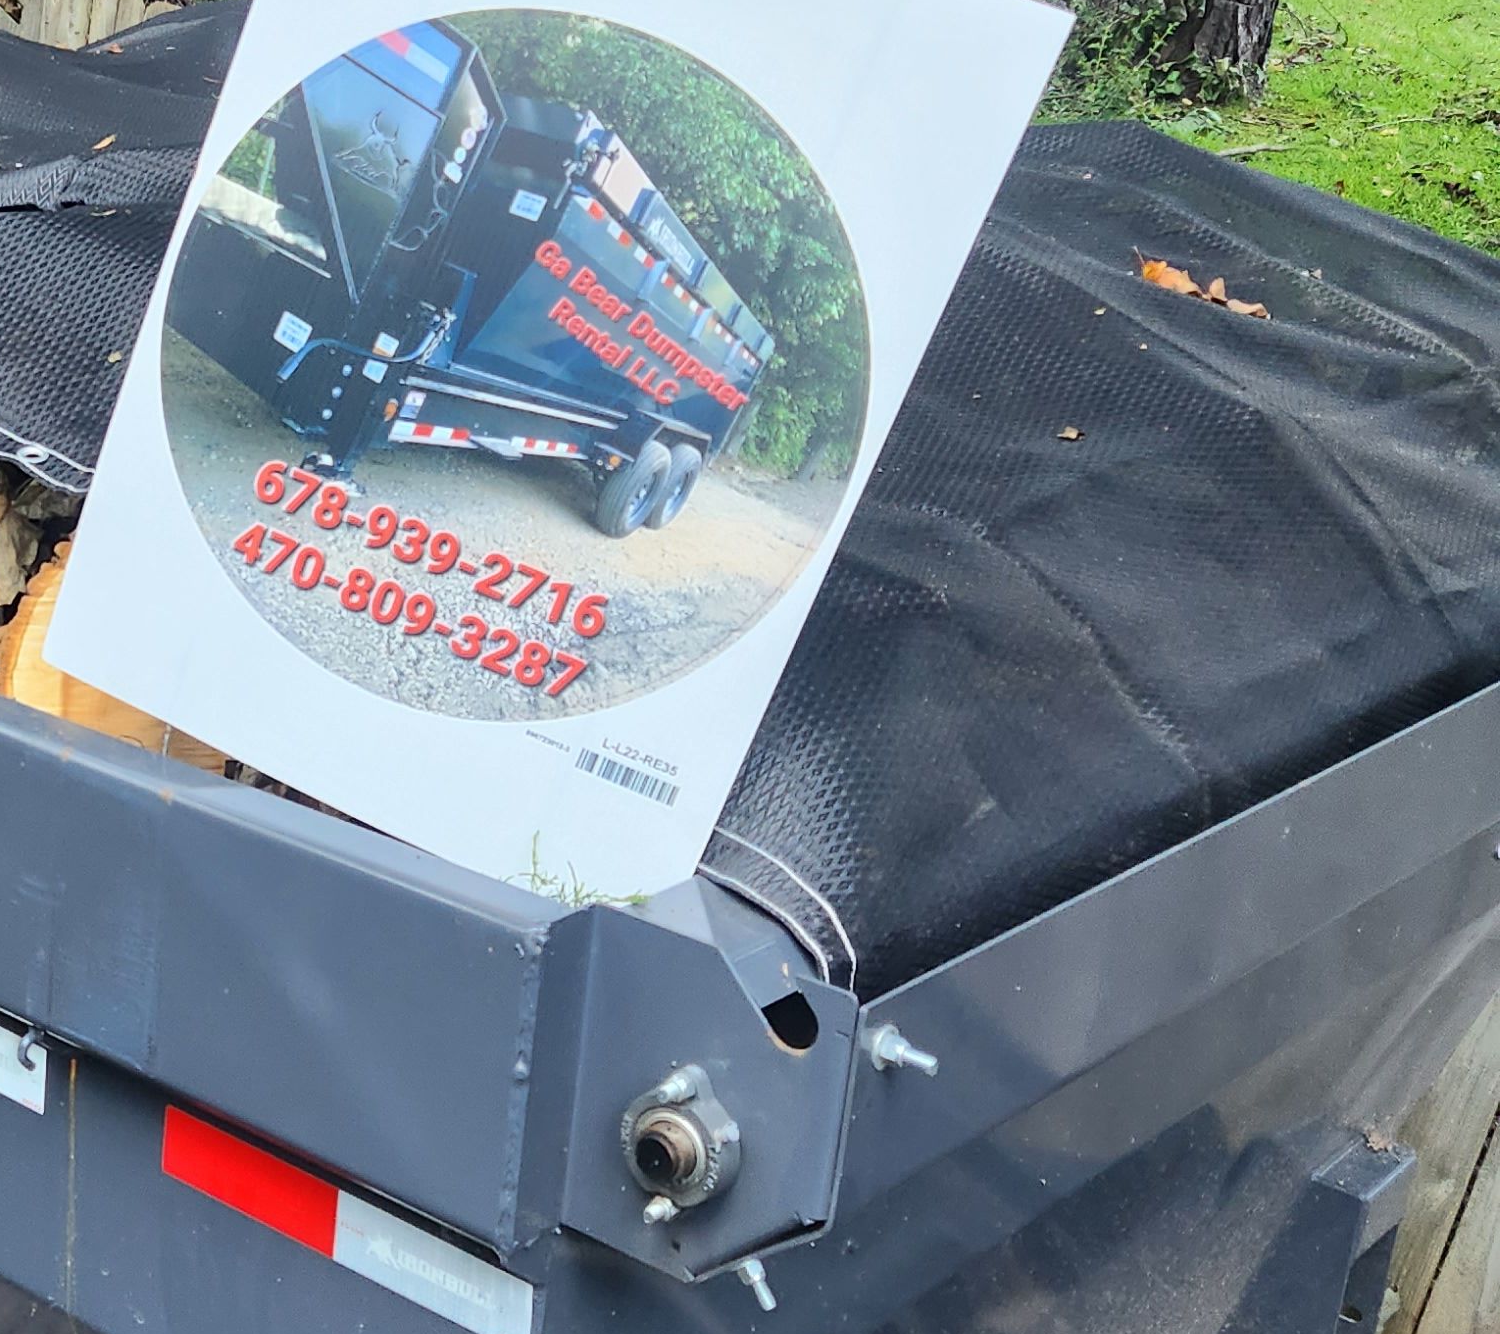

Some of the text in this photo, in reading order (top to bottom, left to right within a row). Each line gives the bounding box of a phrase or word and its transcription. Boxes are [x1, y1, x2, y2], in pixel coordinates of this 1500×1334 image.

[535, 240, 750, 411] Ga Bear Dumpster
[549, 296, 680, 405] Rental LLC
[232, 522, 588, 698] 470-809-3287
[254, 459, 609, 637] 678-939-2716
[602, 737, 679, 777] L-L22-RE35
